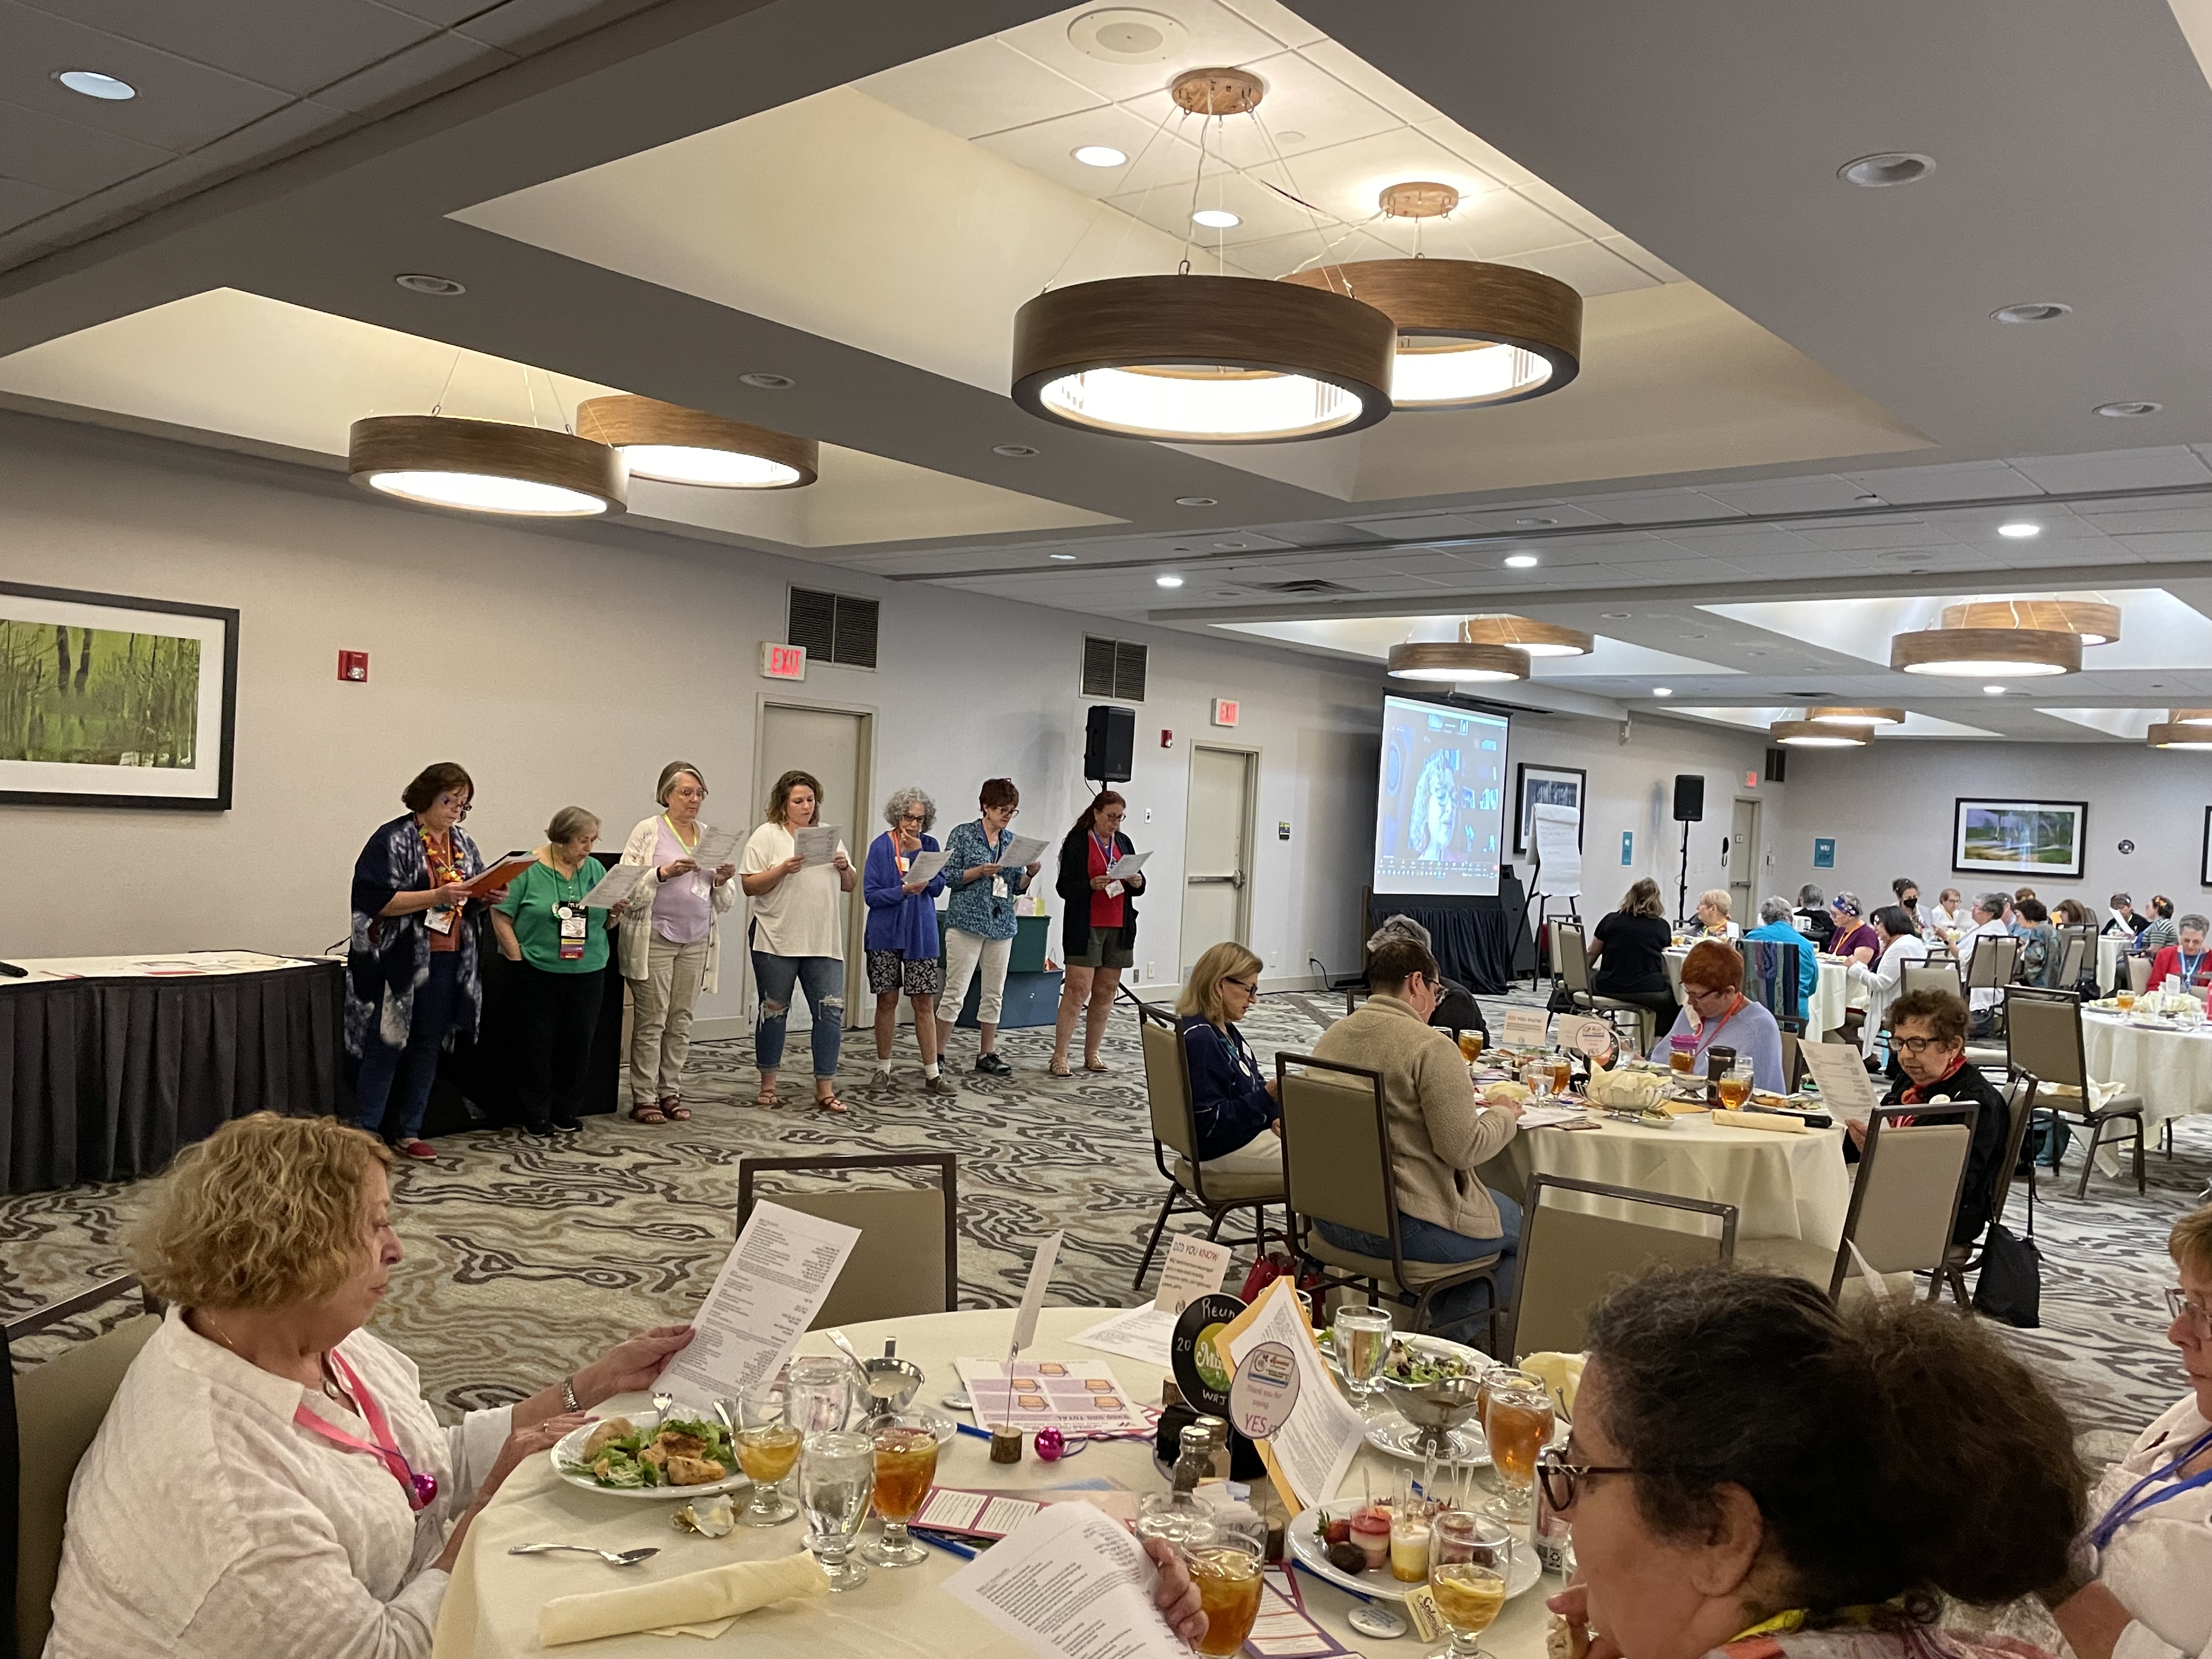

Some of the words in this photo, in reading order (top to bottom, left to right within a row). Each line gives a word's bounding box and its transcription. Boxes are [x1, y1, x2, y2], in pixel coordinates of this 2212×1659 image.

[771, 647, 801, 676] EXIT
[1220, 702, 1237, 723] EXIT
[1173, 1242, 1184, 1252] DID
[1186, 1245, 1199, 1256] YOU
[1199, 1248, 1220, 1261] KNOW
[1177, 1337, 1192, 1352] 20
[1203, 1389, 1228, 1405] WRJ
[1245, 1413, 1268, 1434] YES
